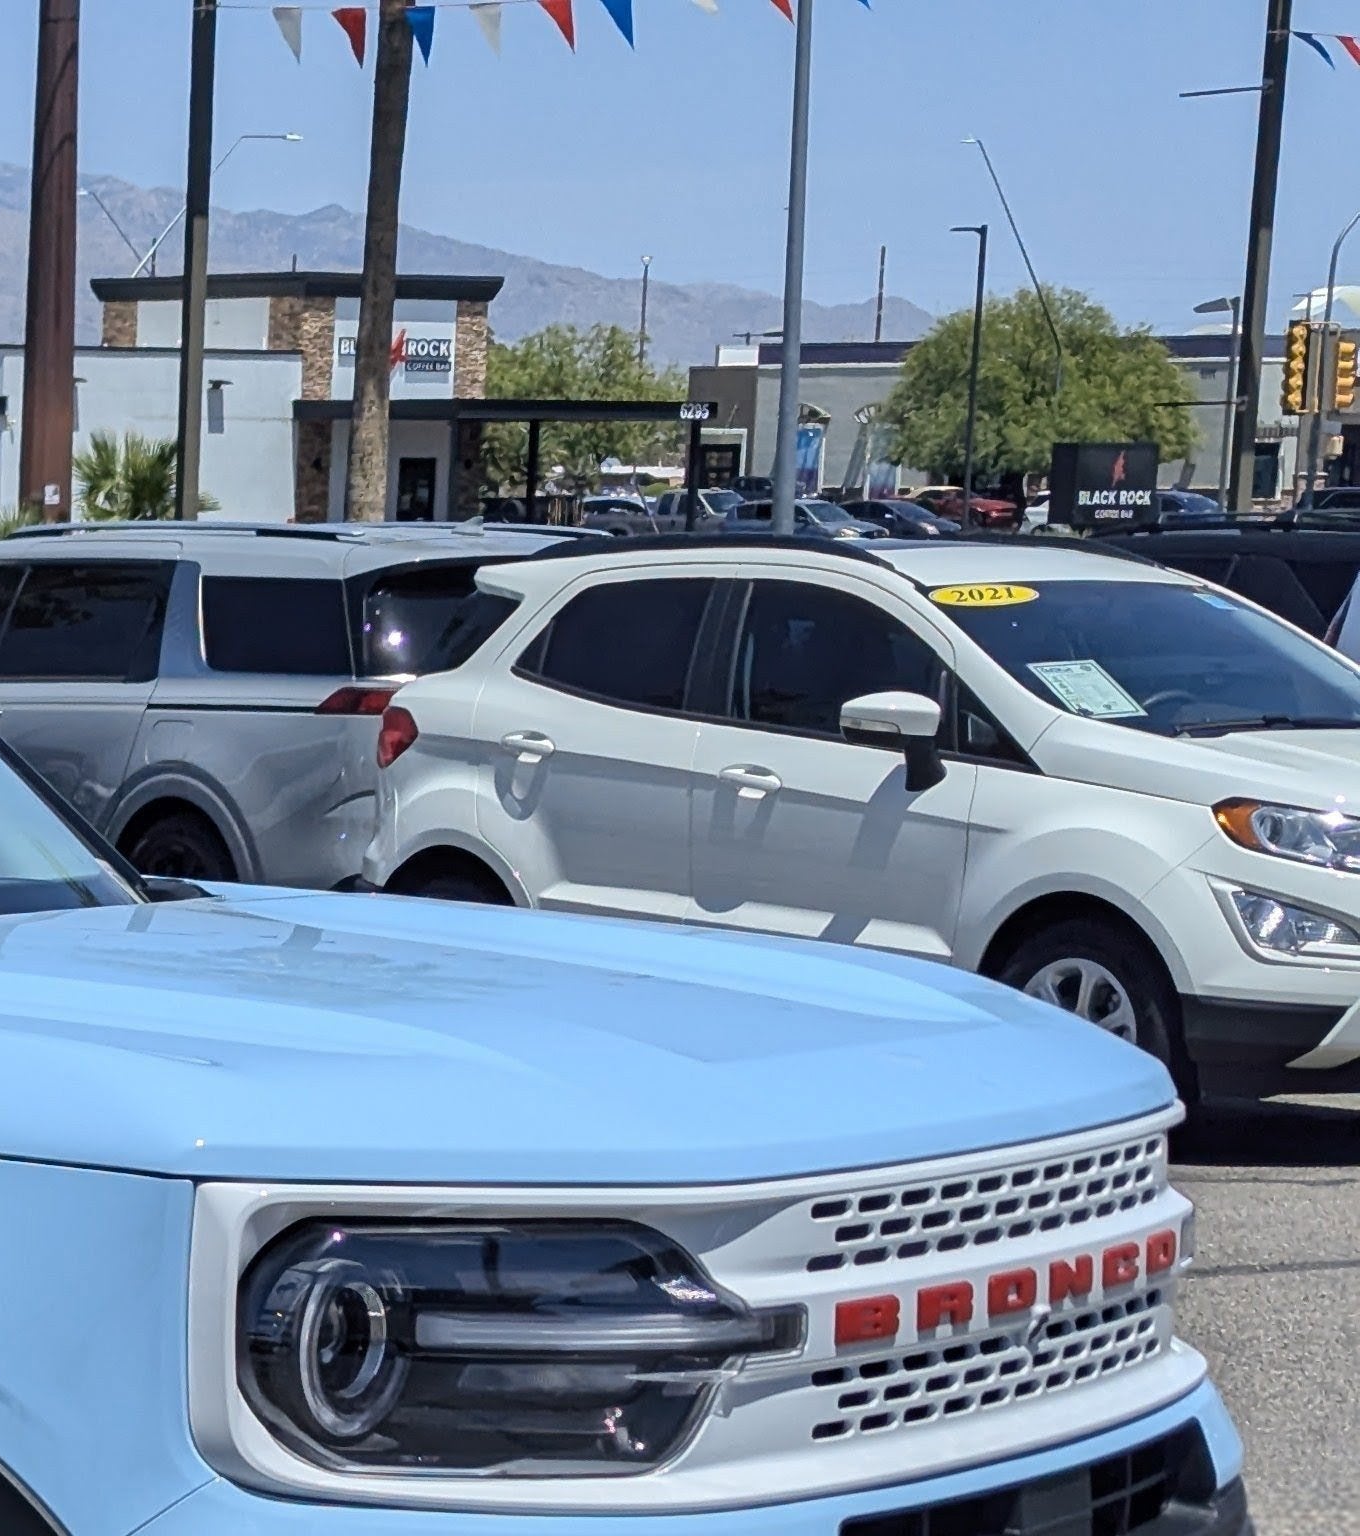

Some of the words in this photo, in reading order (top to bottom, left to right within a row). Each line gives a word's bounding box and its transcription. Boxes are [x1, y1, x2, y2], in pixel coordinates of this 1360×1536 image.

[406, 339, 450, 357] ROCK
[1078, 489, 1118, 506] BLACK
[1119, 489, 1152, 506] ROCK
[951, 586, 1016, 603] 2021
[833, 1228, 1178, 1348] BRONCO
